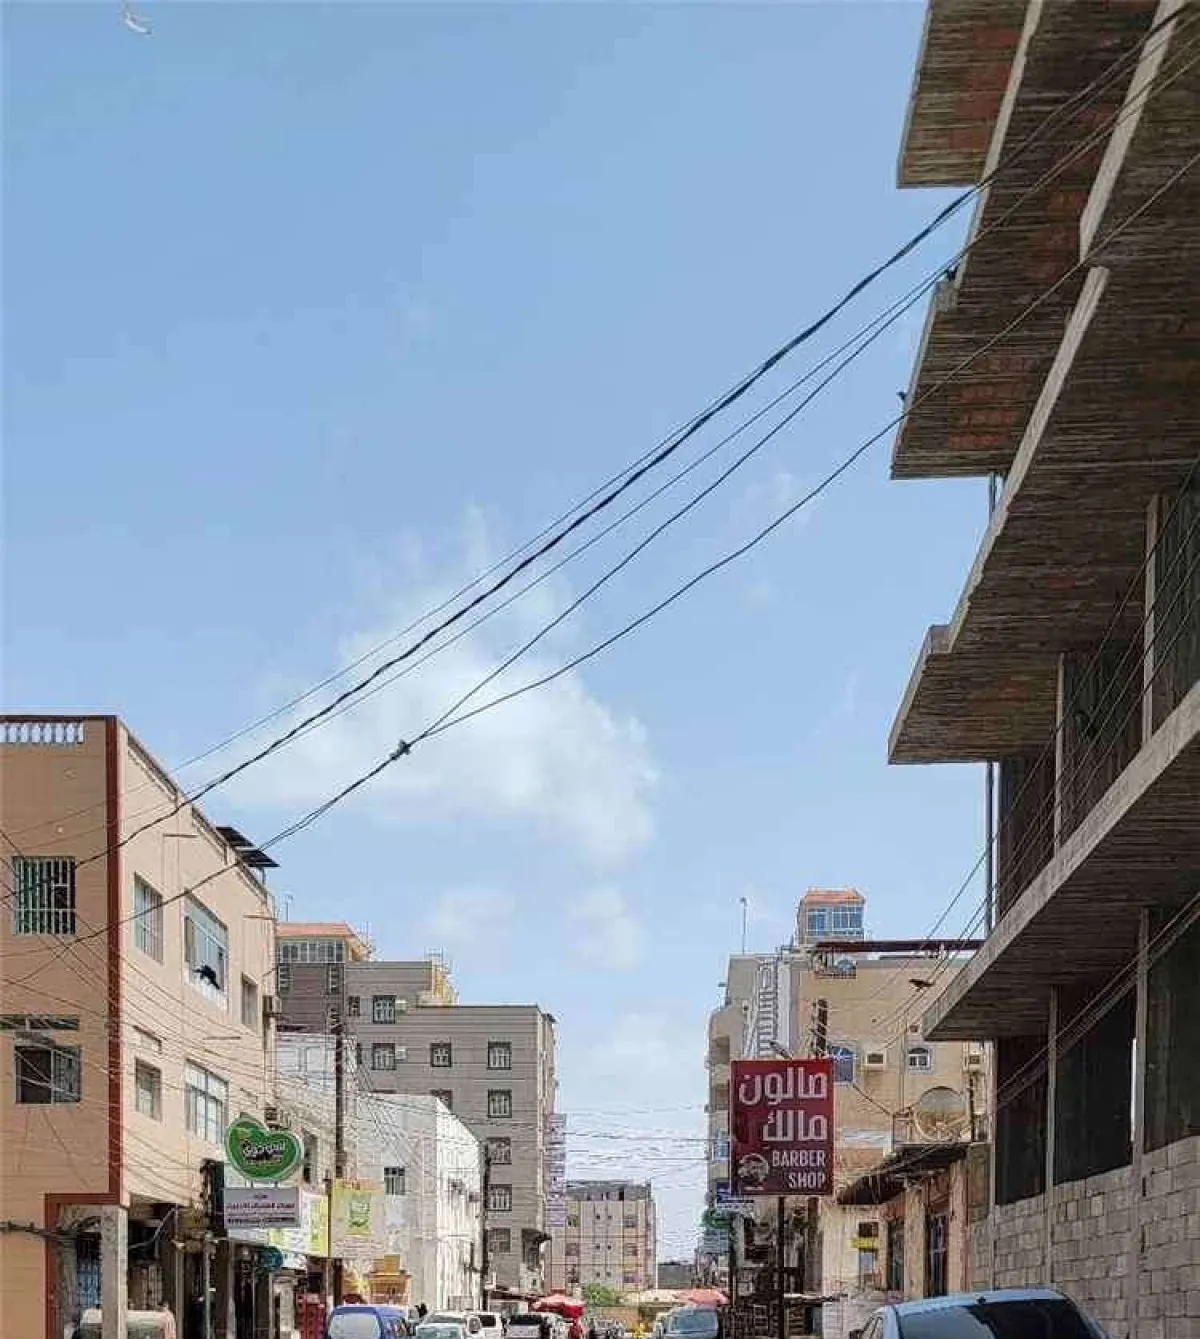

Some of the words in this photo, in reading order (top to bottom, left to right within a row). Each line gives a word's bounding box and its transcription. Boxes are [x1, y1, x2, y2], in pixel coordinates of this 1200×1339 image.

[738, 1067, 828, 1106] صالون
[762, 1110, 828, 1142] مالك
[772, 1149, 826, 1167] BARBER
[788, 1171, 826, 1188] SHOP
